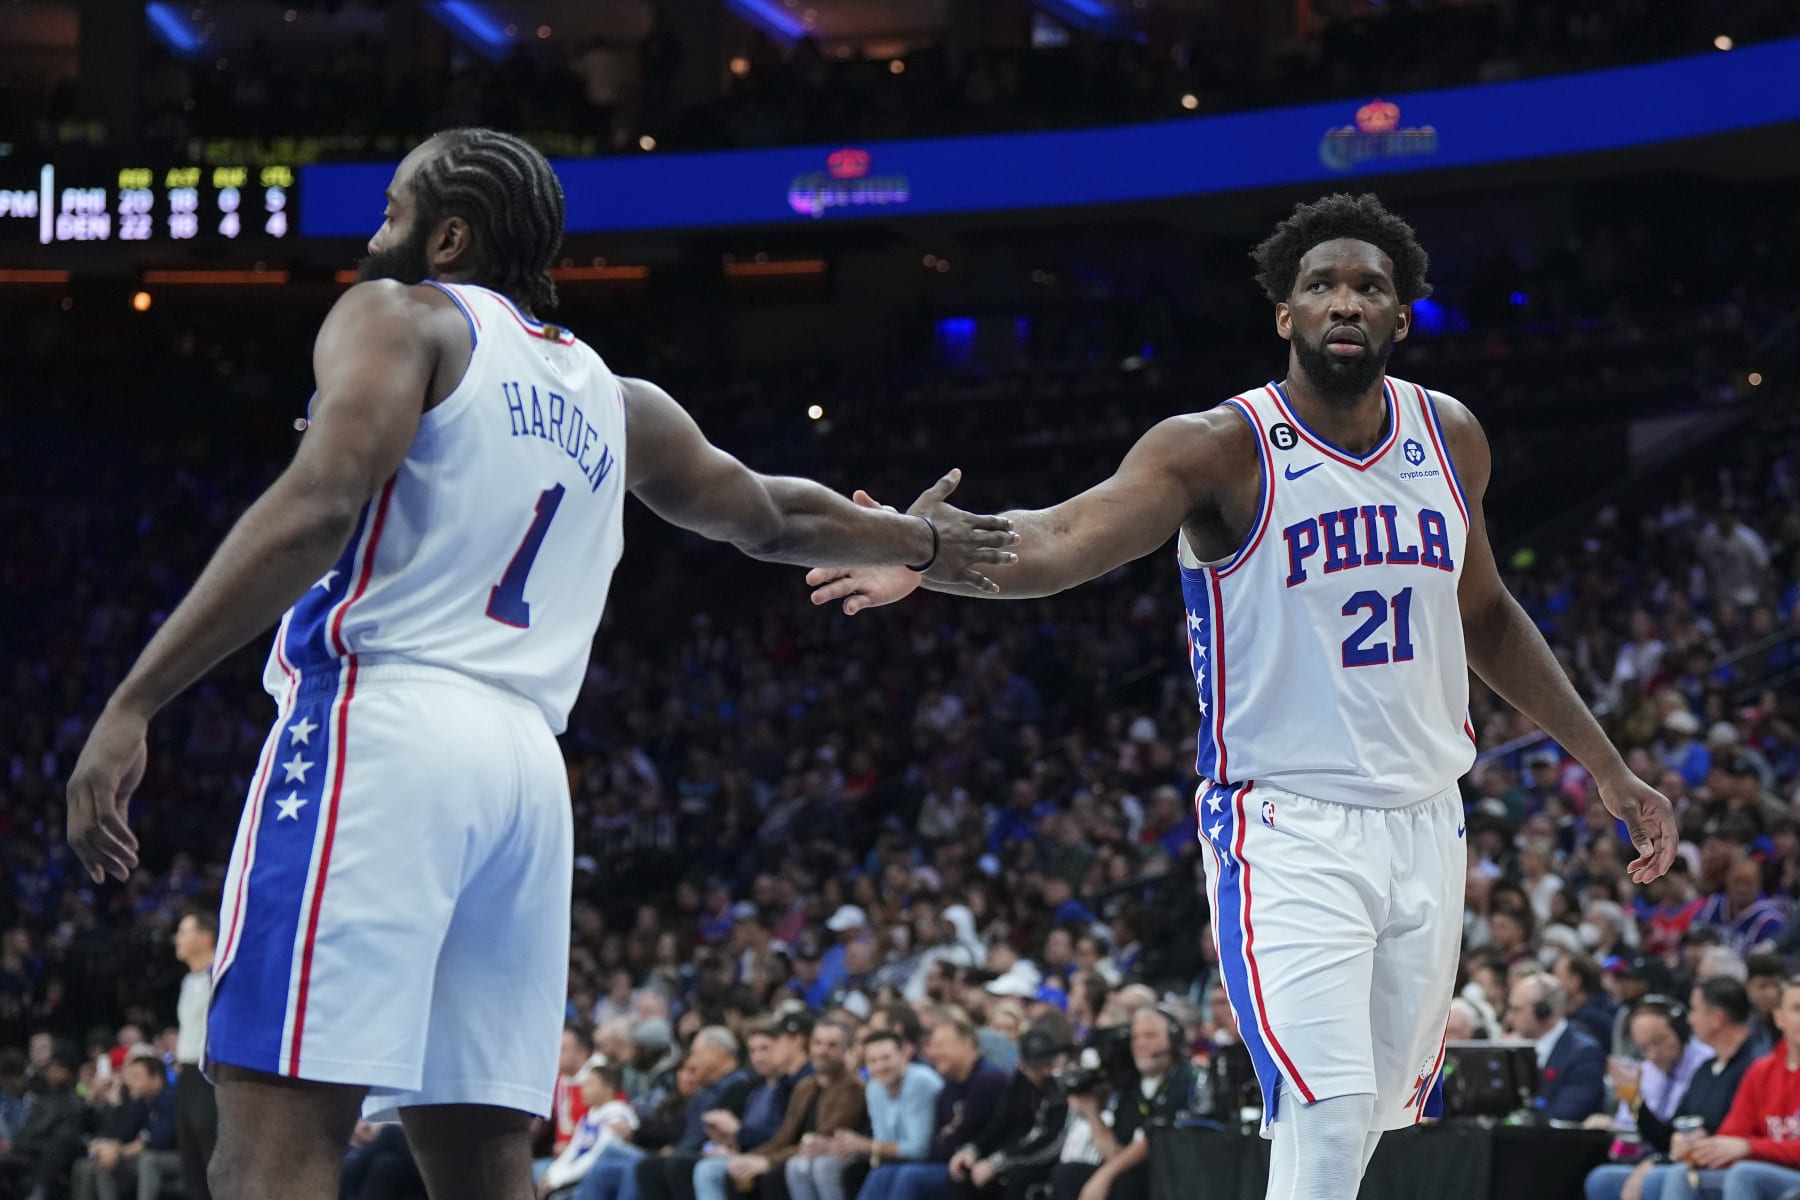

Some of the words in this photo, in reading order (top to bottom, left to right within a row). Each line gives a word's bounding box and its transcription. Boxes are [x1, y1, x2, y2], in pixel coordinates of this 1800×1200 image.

[56, 213, 111, 240] DEN
[118, 213, 153, 240] 22
[218, 212, 241, 238] 4
[265, 211, 288, 238] 4
[61, 188, 107, 214] PHI
[502, 381, 614, 493] HARDEN
[1274, 426, 1292, 447] 6
[1400, 470, 1440, 480] crypto.com
[485, 482, 566, 629] 1
[1283, 504, 1454, 588] PHILA
[1342, 587, 1414, 668] 21
